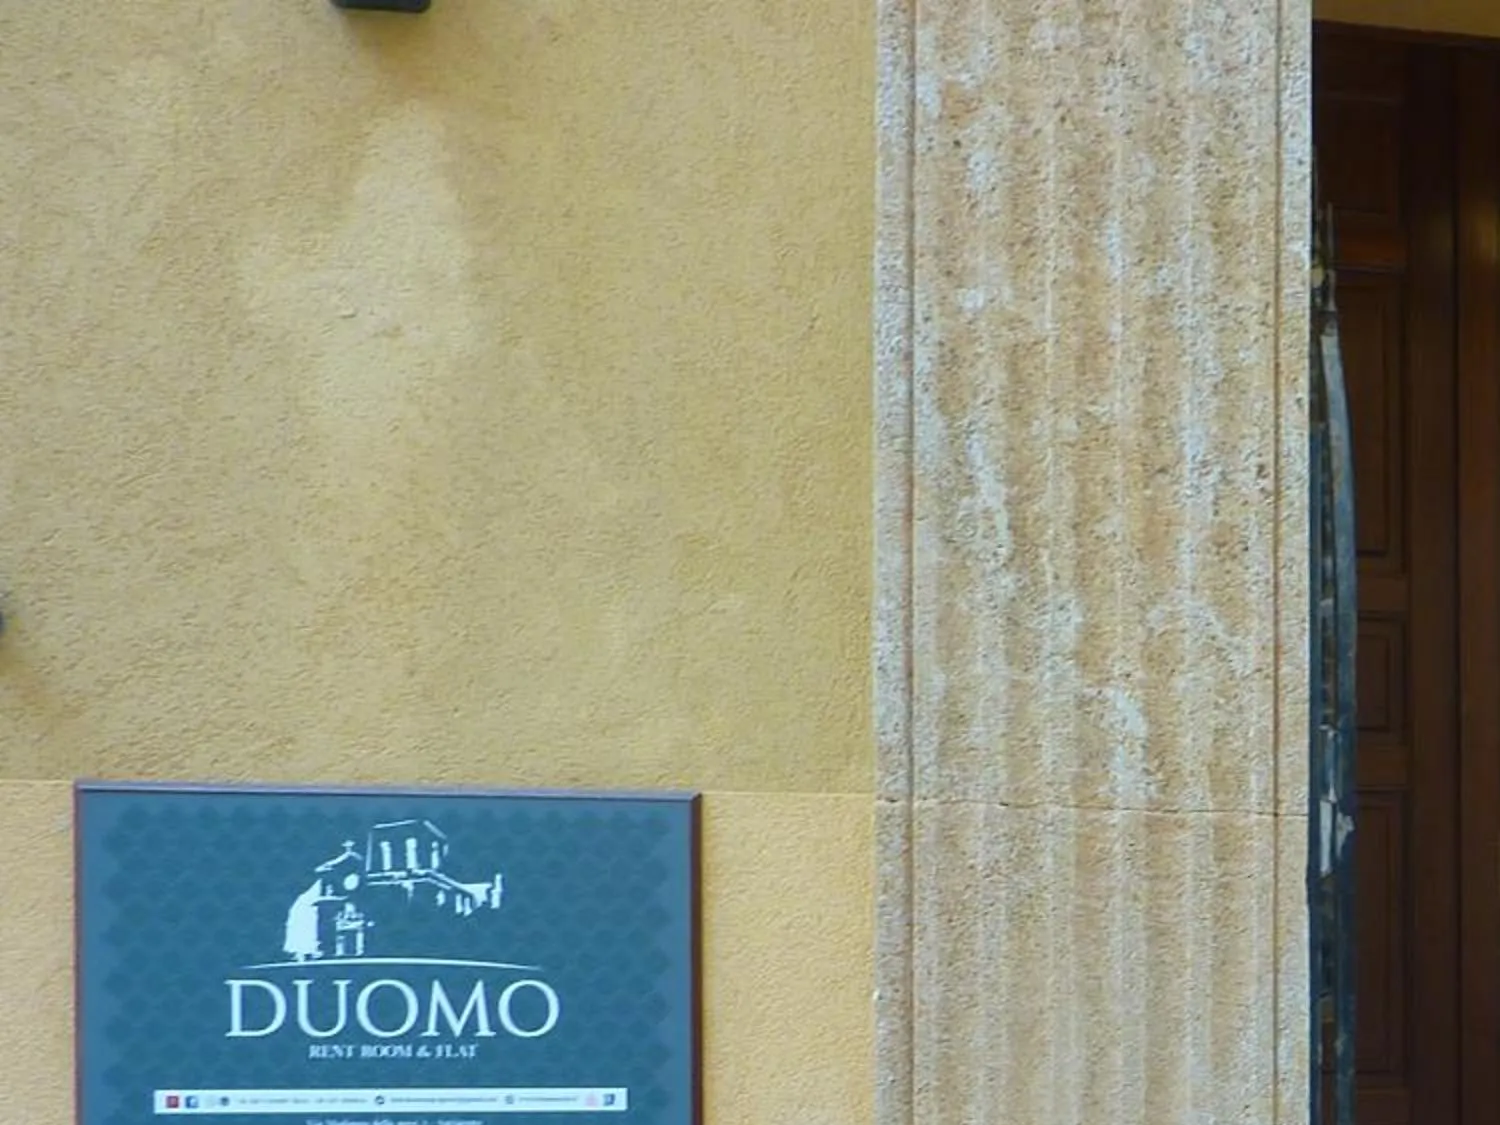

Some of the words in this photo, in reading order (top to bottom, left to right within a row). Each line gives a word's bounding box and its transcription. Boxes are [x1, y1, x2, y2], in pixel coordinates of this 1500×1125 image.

[224, 979, 560, 1037] DUOMO
[308, 1044, 355, 1059] RENT
[361, 1044, 412, 1059] ROOM
[416, 1044, 432, 1059] &
